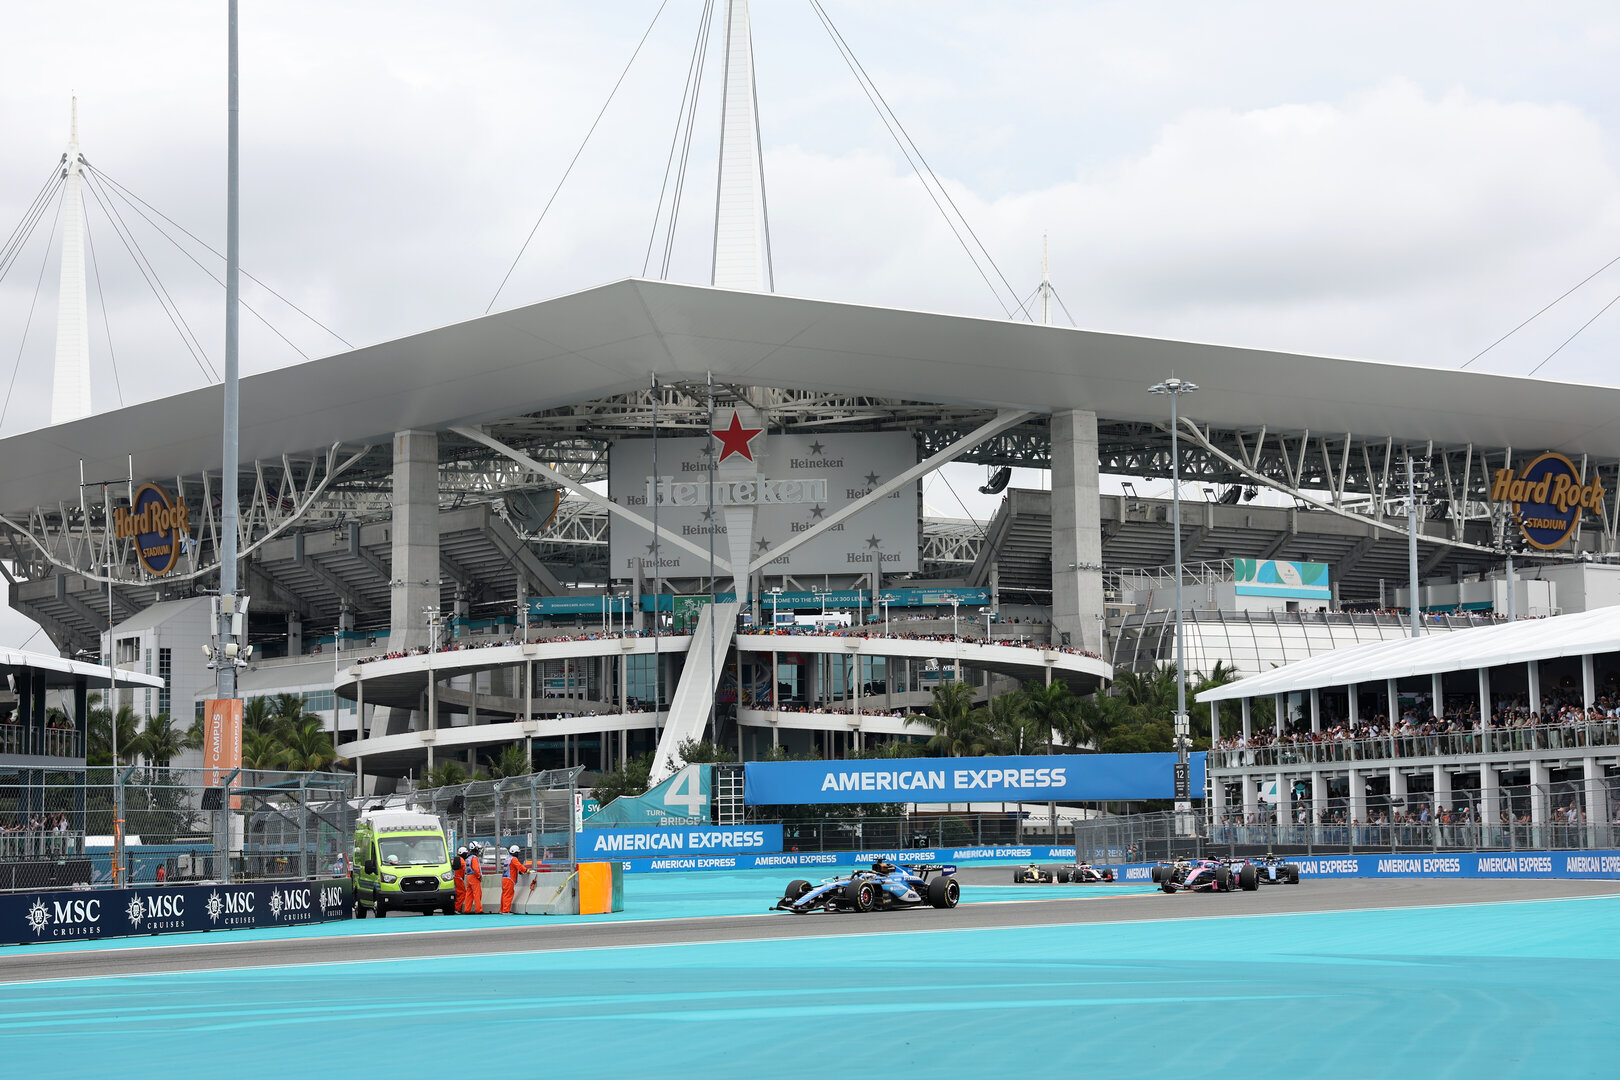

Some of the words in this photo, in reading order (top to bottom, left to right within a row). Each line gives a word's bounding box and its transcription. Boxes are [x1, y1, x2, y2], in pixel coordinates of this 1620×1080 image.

[790, 457, 844, 468] Heineken
[646, 472, 827, 507] Heineken
[1491, 468, 1552, 504] Hard
[1550, 476, 1605, 515] Rock
[113, 502, 151, 539] Hard
[151, 496, 191, 538] Rock
[1526, 517, 1567, 530] STADIUM
[143, 545, 171, 558] STADIUM
[846, 553, 901, 563] Heinken
[627, 558, 681, 569] Hineken
[213, 713, 221, 762] CAMPUS
[820, 771, 945, 792] AMERICAN
[953, 768, 1067, 789] EXPRESS
[1176, 770, 1184, 778] 12
[664, 764, 707, 816] 4
[660, 816, 701, 826] BRIDGE
[594, 833, 684, 851] AMERICAN
[688, 831, 764, 849] EXPRESS
[755, 856, 798, 865] AMERICAN
[800, 854, 837, 864] EXPRESS
[855, 853, 897, 862] AMERICAN
[899, 852, 935, 861] EXPRESS
[953, 850, 994, 859] AMERICAN
[996, 849, 1031, 857] EXPRESS
[651, 860, 692, 869] AMERICAN
[697, 858, 736, 868] EXPRESS
[1320, 860, 1359, 873] EXPRESS
[1378, 859, 1421, 873] AMERICAN
[1423, 858, 1460, 872] EXPRESS
[1478, 858, 1519, 873] AMERICAN
[1519, 857, 1552, 872] EXPRESS
[1566, 857, 1600, 872] AMERICAN
[1125, 868, 1153, 880] AMERICAN
[225, 891, 255, 914] MSC
[283, 888, 311, 911] MSC
[327, 886, 343, 907] MSC
[53, 899, 101, 924] MSC
[147, 894, 185, 918] MSC
[225, 916, 255, 925] CRUISES
[283, 912, 311, 920] CRUISES
[53, 926, 101, 936] CRUISES
[147, 920, 185, 929] CRUISES
